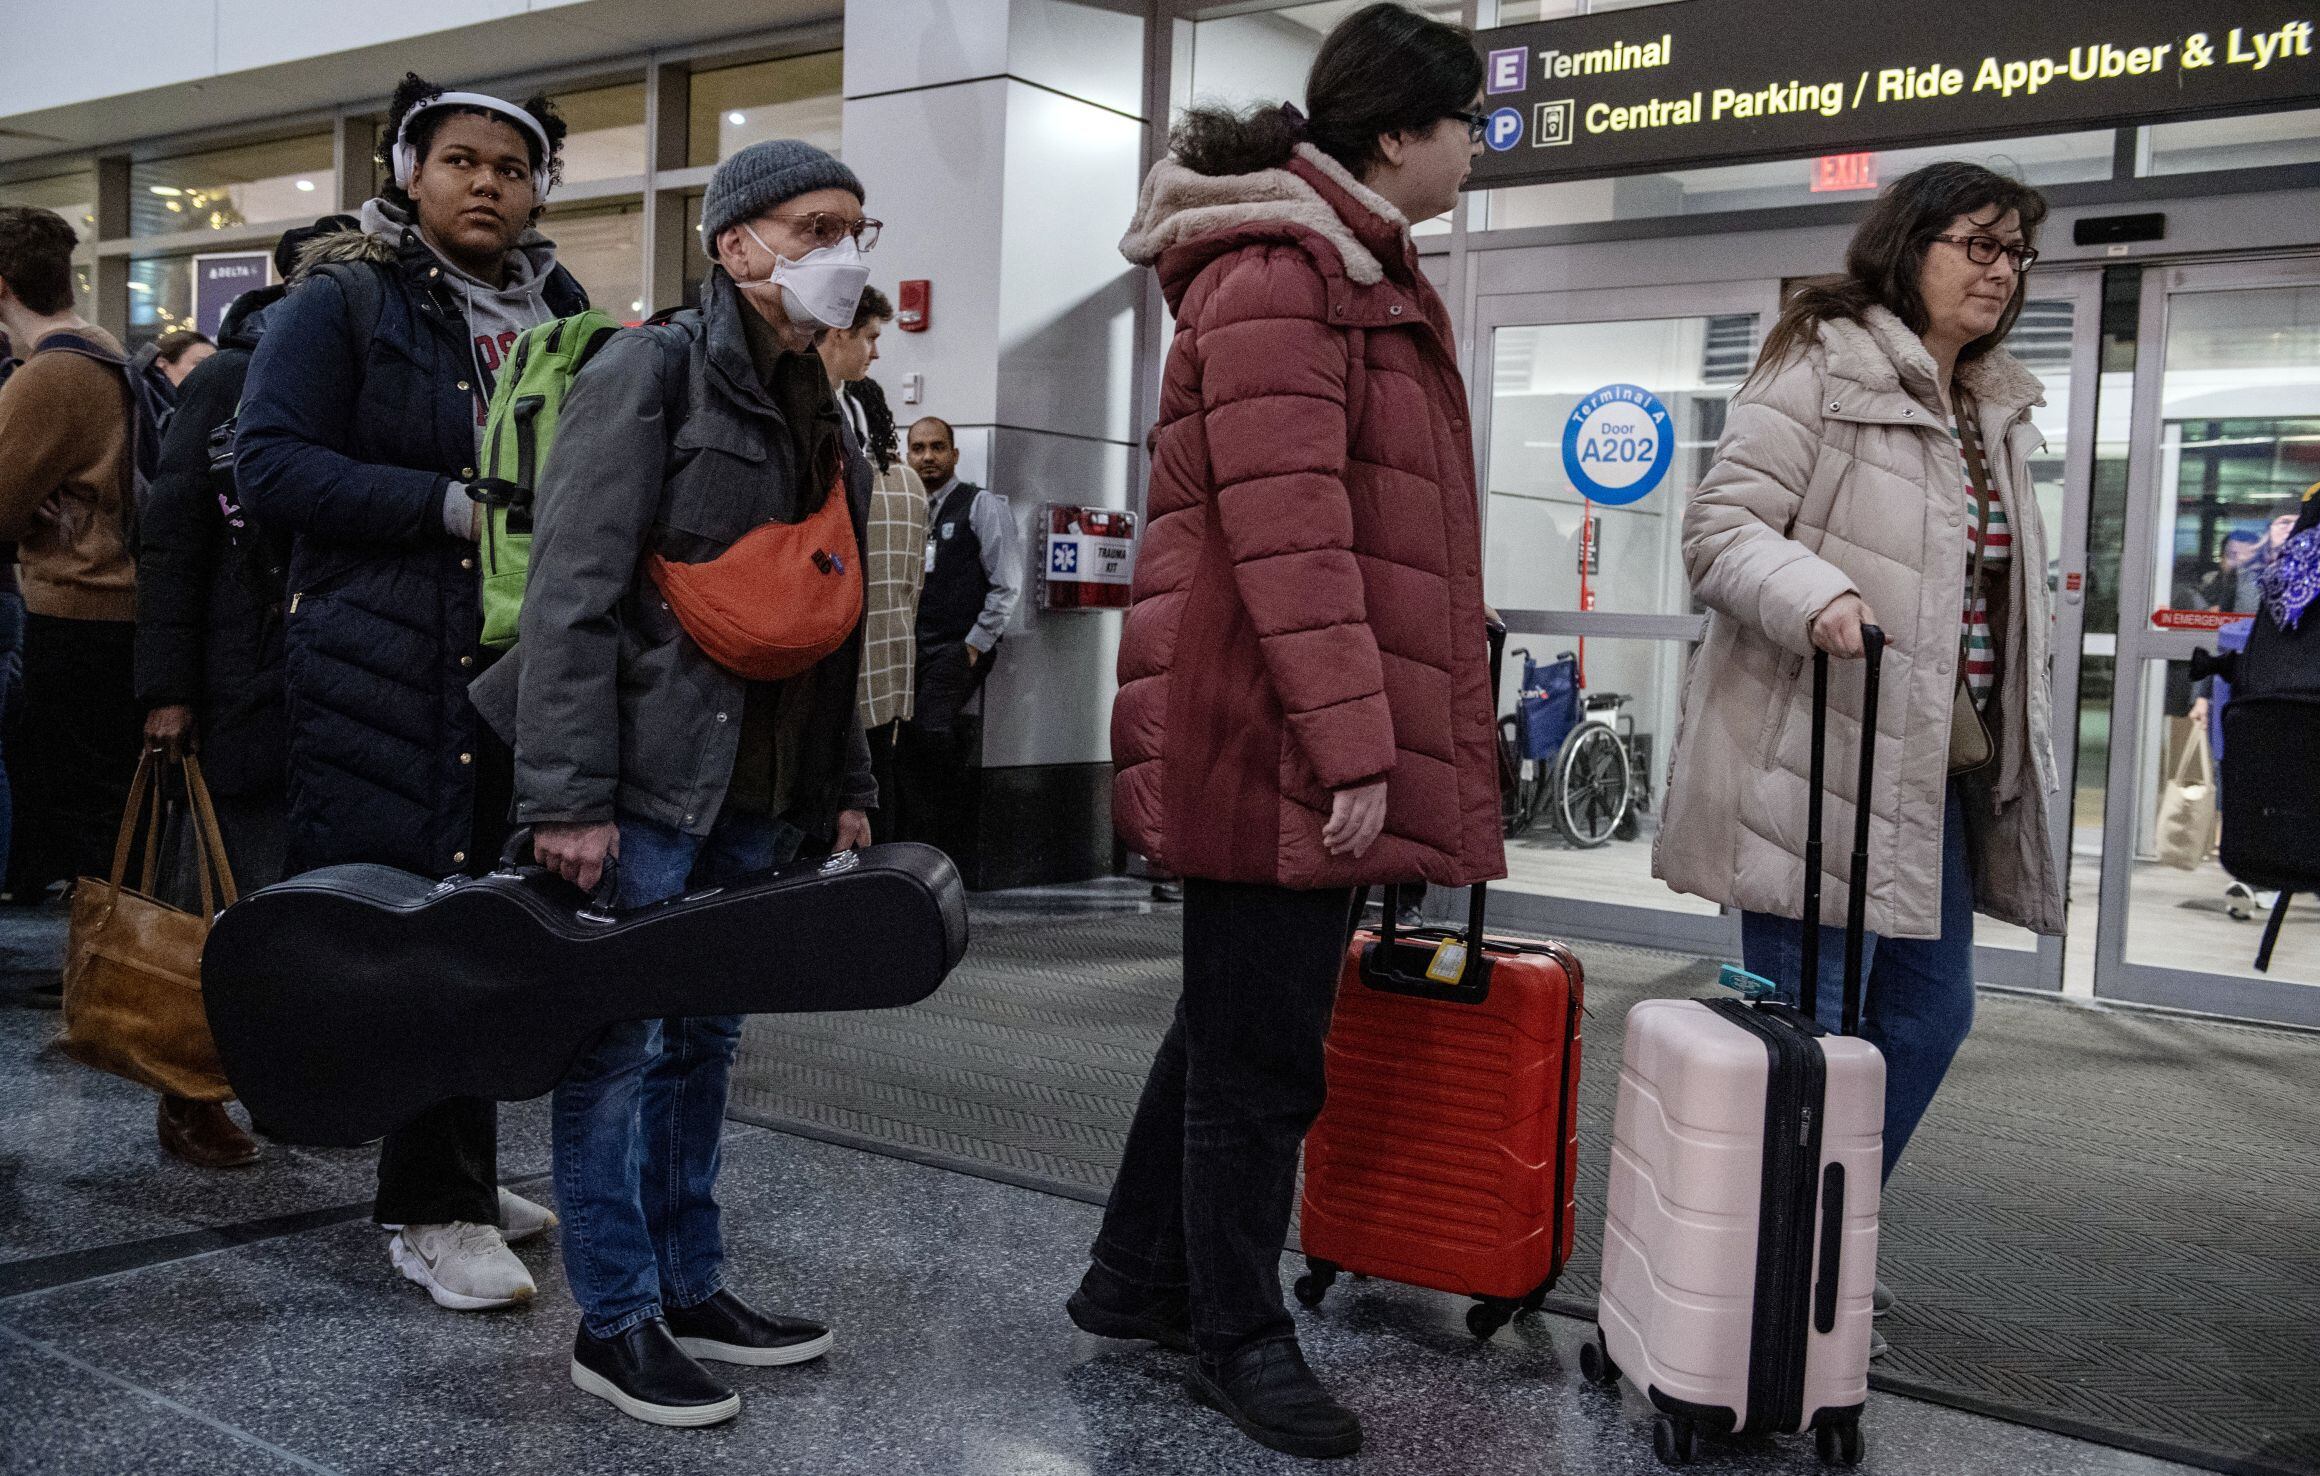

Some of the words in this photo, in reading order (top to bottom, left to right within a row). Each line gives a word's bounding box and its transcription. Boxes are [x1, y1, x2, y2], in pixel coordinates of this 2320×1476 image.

[1495, 55, 1519, 87] E
[1538, 34, 1672, 80] Terminal
[1495, 121, 1517, 144] P
[1585, 91, 1702, 134] Central
[1711, 80, 1844, 121] Parking
[1876, 64, 1964, 103] Ride
[1972, 43, 2172, 97] App-Uber
[2180, 32, 2215, 70] &
[2226, 20, 2315, 70] Lyft
[1821, 153, 1873, 186] EXIT
[218, 266, 250, 278] DELTA
[1571, 386, 1652, 424] Terminal
[1652, 410, 1666, 424] A
[1601, 422, 1636, 435] Door
[1581, 438, 1654, 462] A202
[1099, 547, 1126, 560] TRAUMA
[1106, 563, 1118, 573] KIT
[2162, 613, 2172, 624] IN
